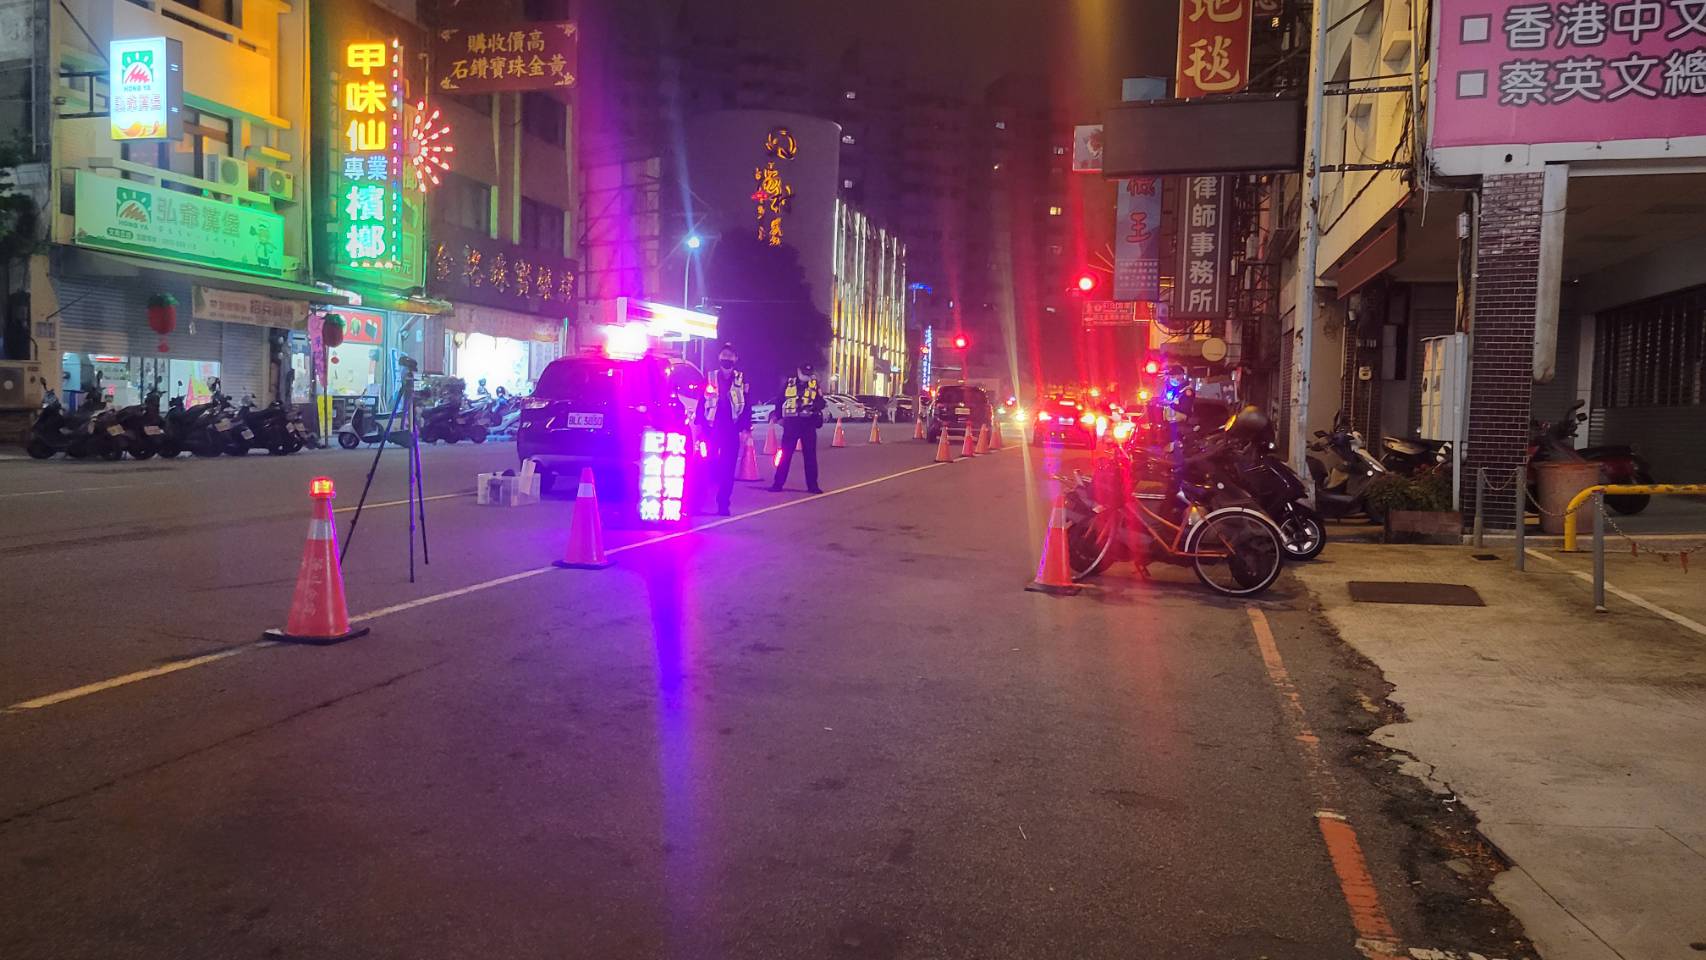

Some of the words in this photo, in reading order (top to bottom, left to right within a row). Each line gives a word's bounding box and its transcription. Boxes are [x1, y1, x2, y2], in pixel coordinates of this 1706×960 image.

[1504, 0, 1706, 48] 香港中文
[346, 42, 388, 152] 甲味仙
[1501, 50, 1706, 104] 蔡英文總
[344, 155, 388, 181] 專業
[345, 184, 387, 259] 檳榔
[1188, 176, 1218, 313] 律師事務所
